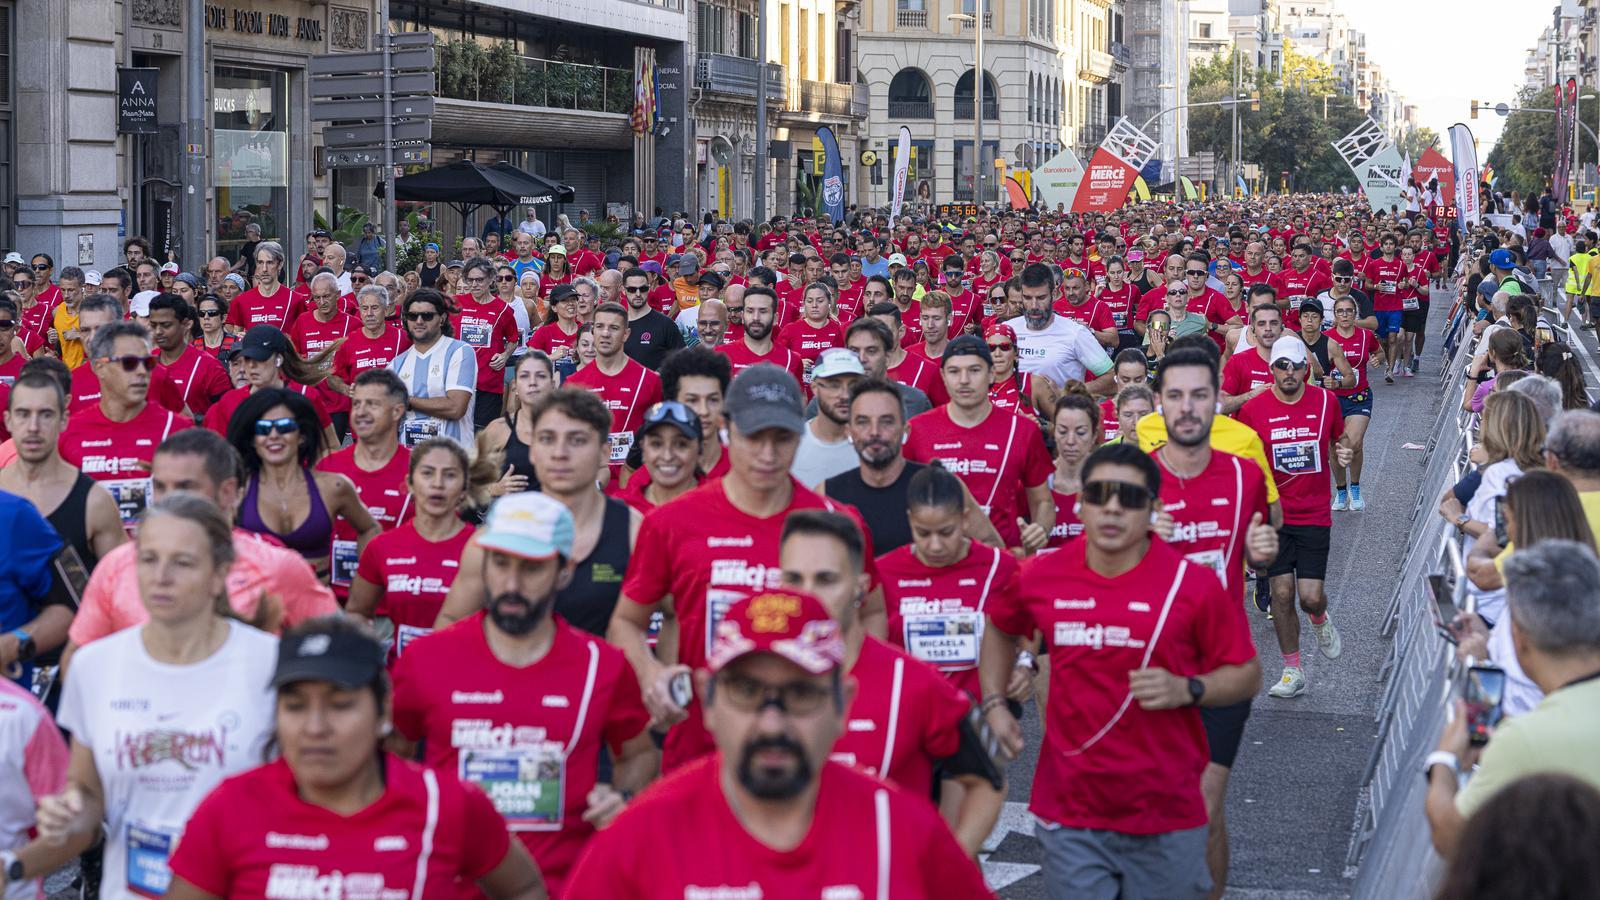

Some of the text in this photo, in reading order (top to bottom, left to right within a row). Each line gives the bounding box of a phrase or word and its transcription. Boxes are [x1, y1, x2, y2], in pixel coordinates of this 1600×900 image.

[233, 9, 262, 34] ROOM
[267, 13, 290, 38] MATE
[296, 17, 322, 41] ANNA
[131, 80, 145, 95] A
[121, 97, 155, 107] ANNA
[214, 97, 236, 112] BUCKS
[1091, 167, 1125, 180] MERCÈ
[1417, 165, 1447, 173] Barcona
[1465, 171, 1473, 213] BIMBO
[519, 195, 552, 204] STARBUCKS
[1435, 206, 1445, 216] 18
[1271, 428, 1296, 441] MERCÈ
[1282, 455, 1305, 464] MANUEL
[941, 459, 969, 475] ERCÈ
[918, 638, 966, 648] MICAELA
[491, 781, 541, 799] JOAN
